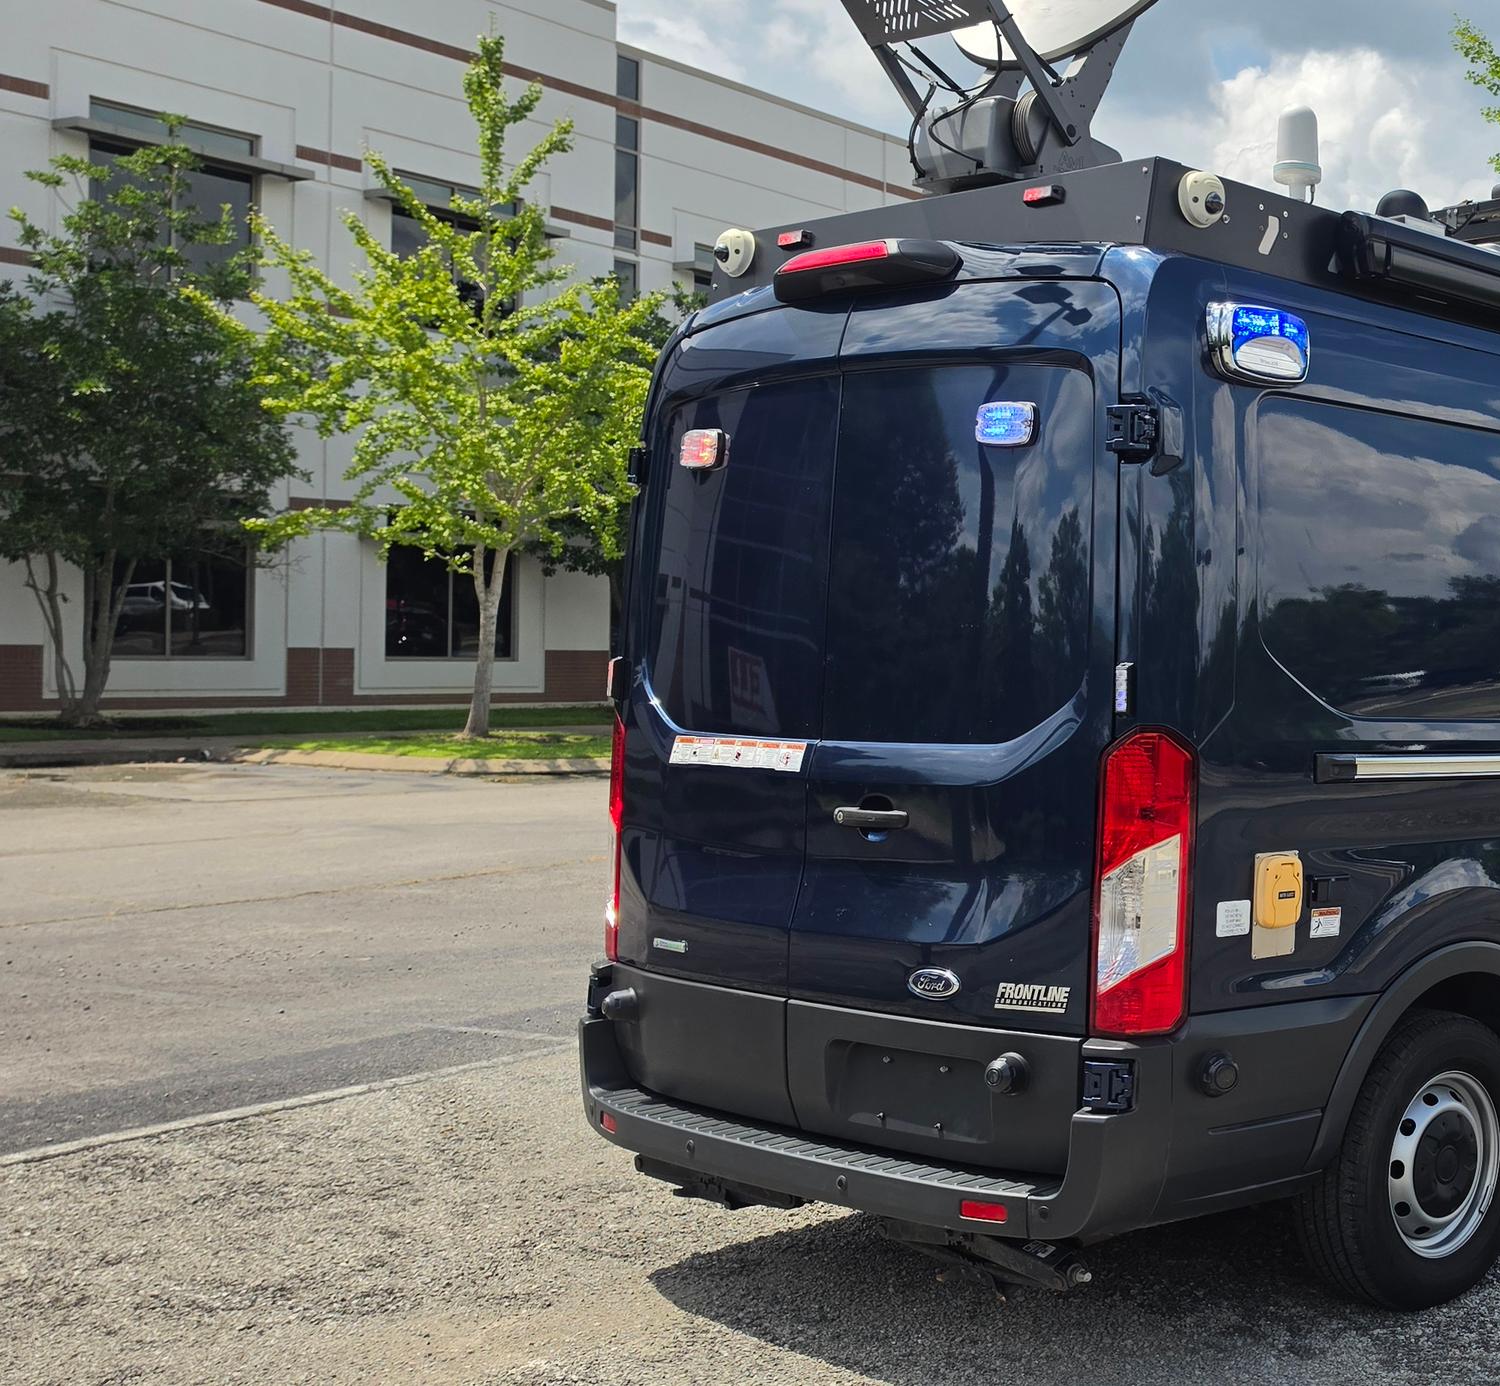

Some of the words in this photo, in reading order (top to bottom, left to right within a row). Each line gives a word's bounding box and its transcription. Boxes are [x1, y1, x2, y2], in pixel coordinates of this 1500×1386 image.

[918, 975, 945, 991] Ford
[996, 982, 1071, 1003] FRONTLINE
[995, 998, 1067, 1008] COMMUNICATIONS
